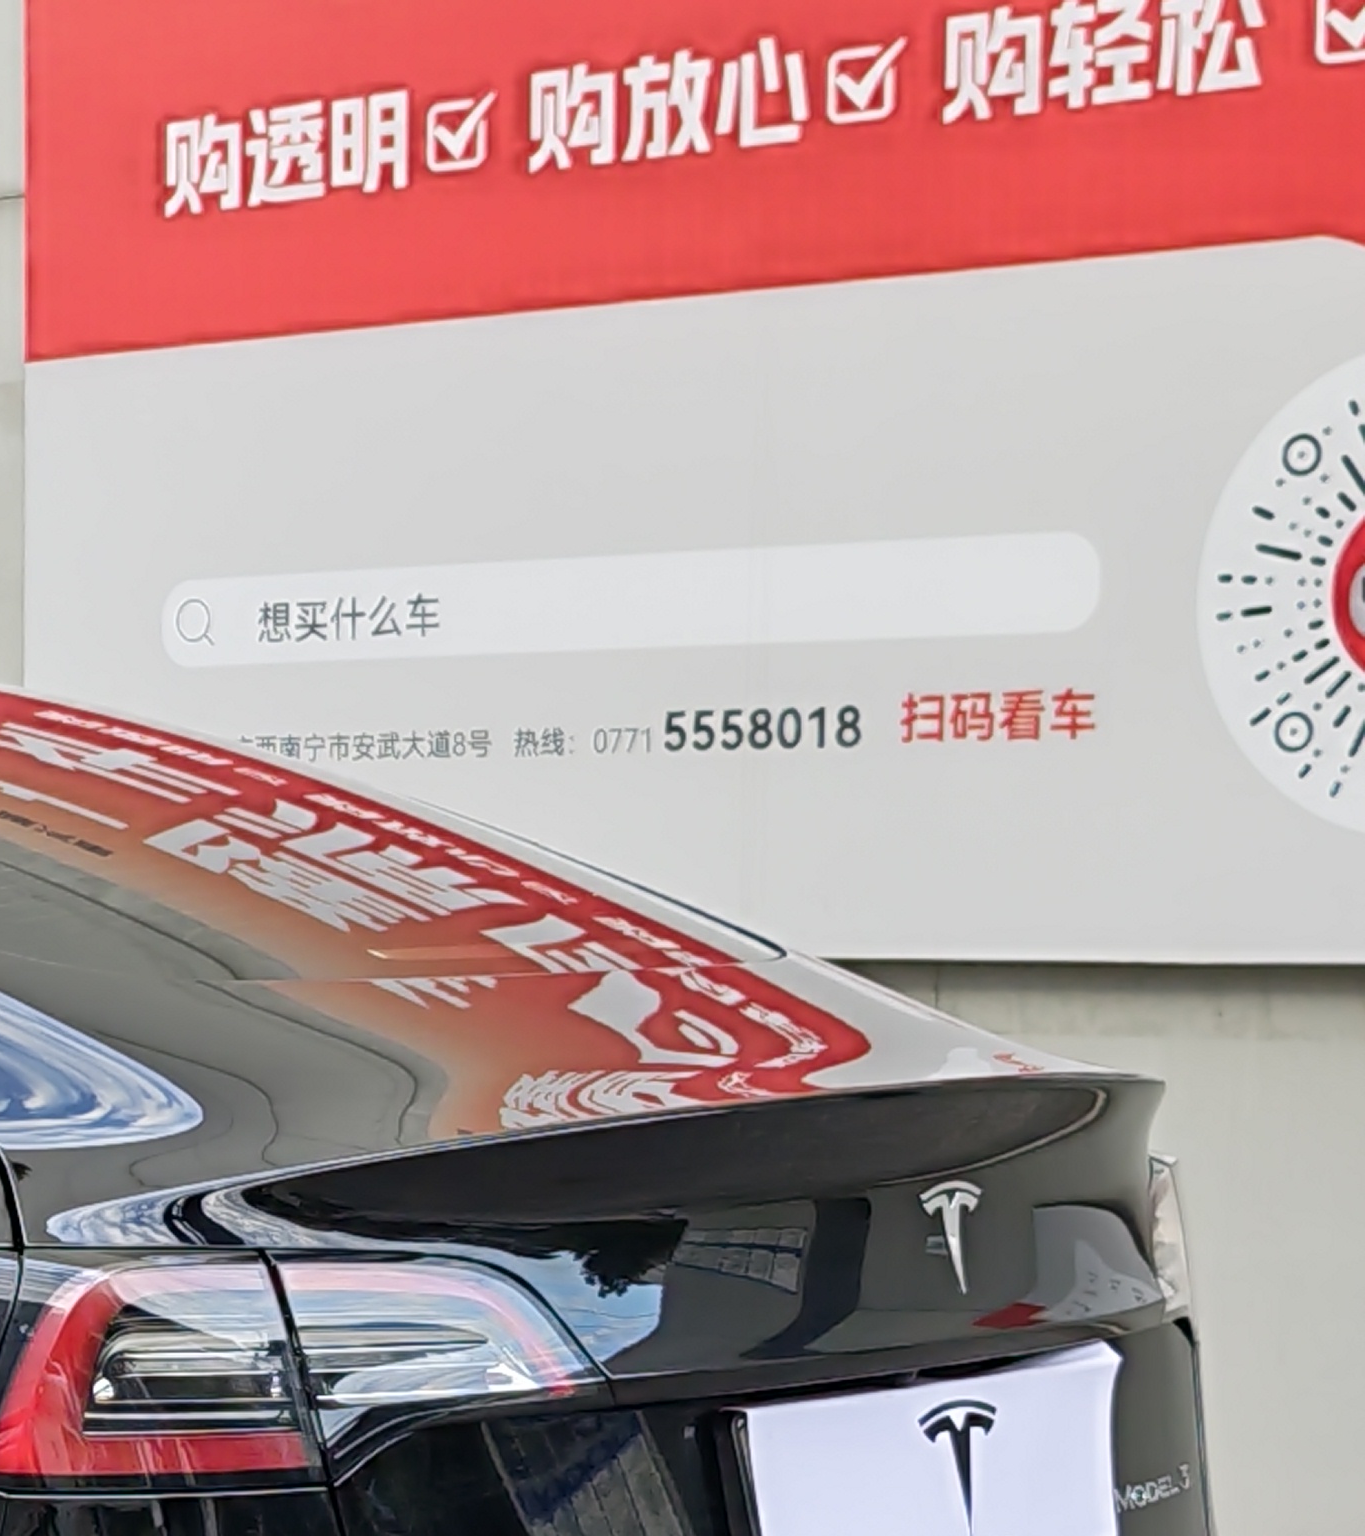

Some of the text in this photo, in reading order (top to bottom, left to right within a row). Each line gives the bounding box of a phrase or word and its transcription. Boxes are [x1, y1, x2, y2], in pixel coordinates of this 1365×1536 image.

[528, 37, 806, 174] 购放心
[942, 0, 1265, 124] 购轻松
[163, 89, 408, 218] 购透明
[256, 593, 440, 643] 想买什么车
[593, 727, 652, 754] 0771
[664, 704, 862, 752] 5558018
[899, 688, 1098, 743] 扫码看车
[1113, 1463, 1191, 1514] MODEL 3
